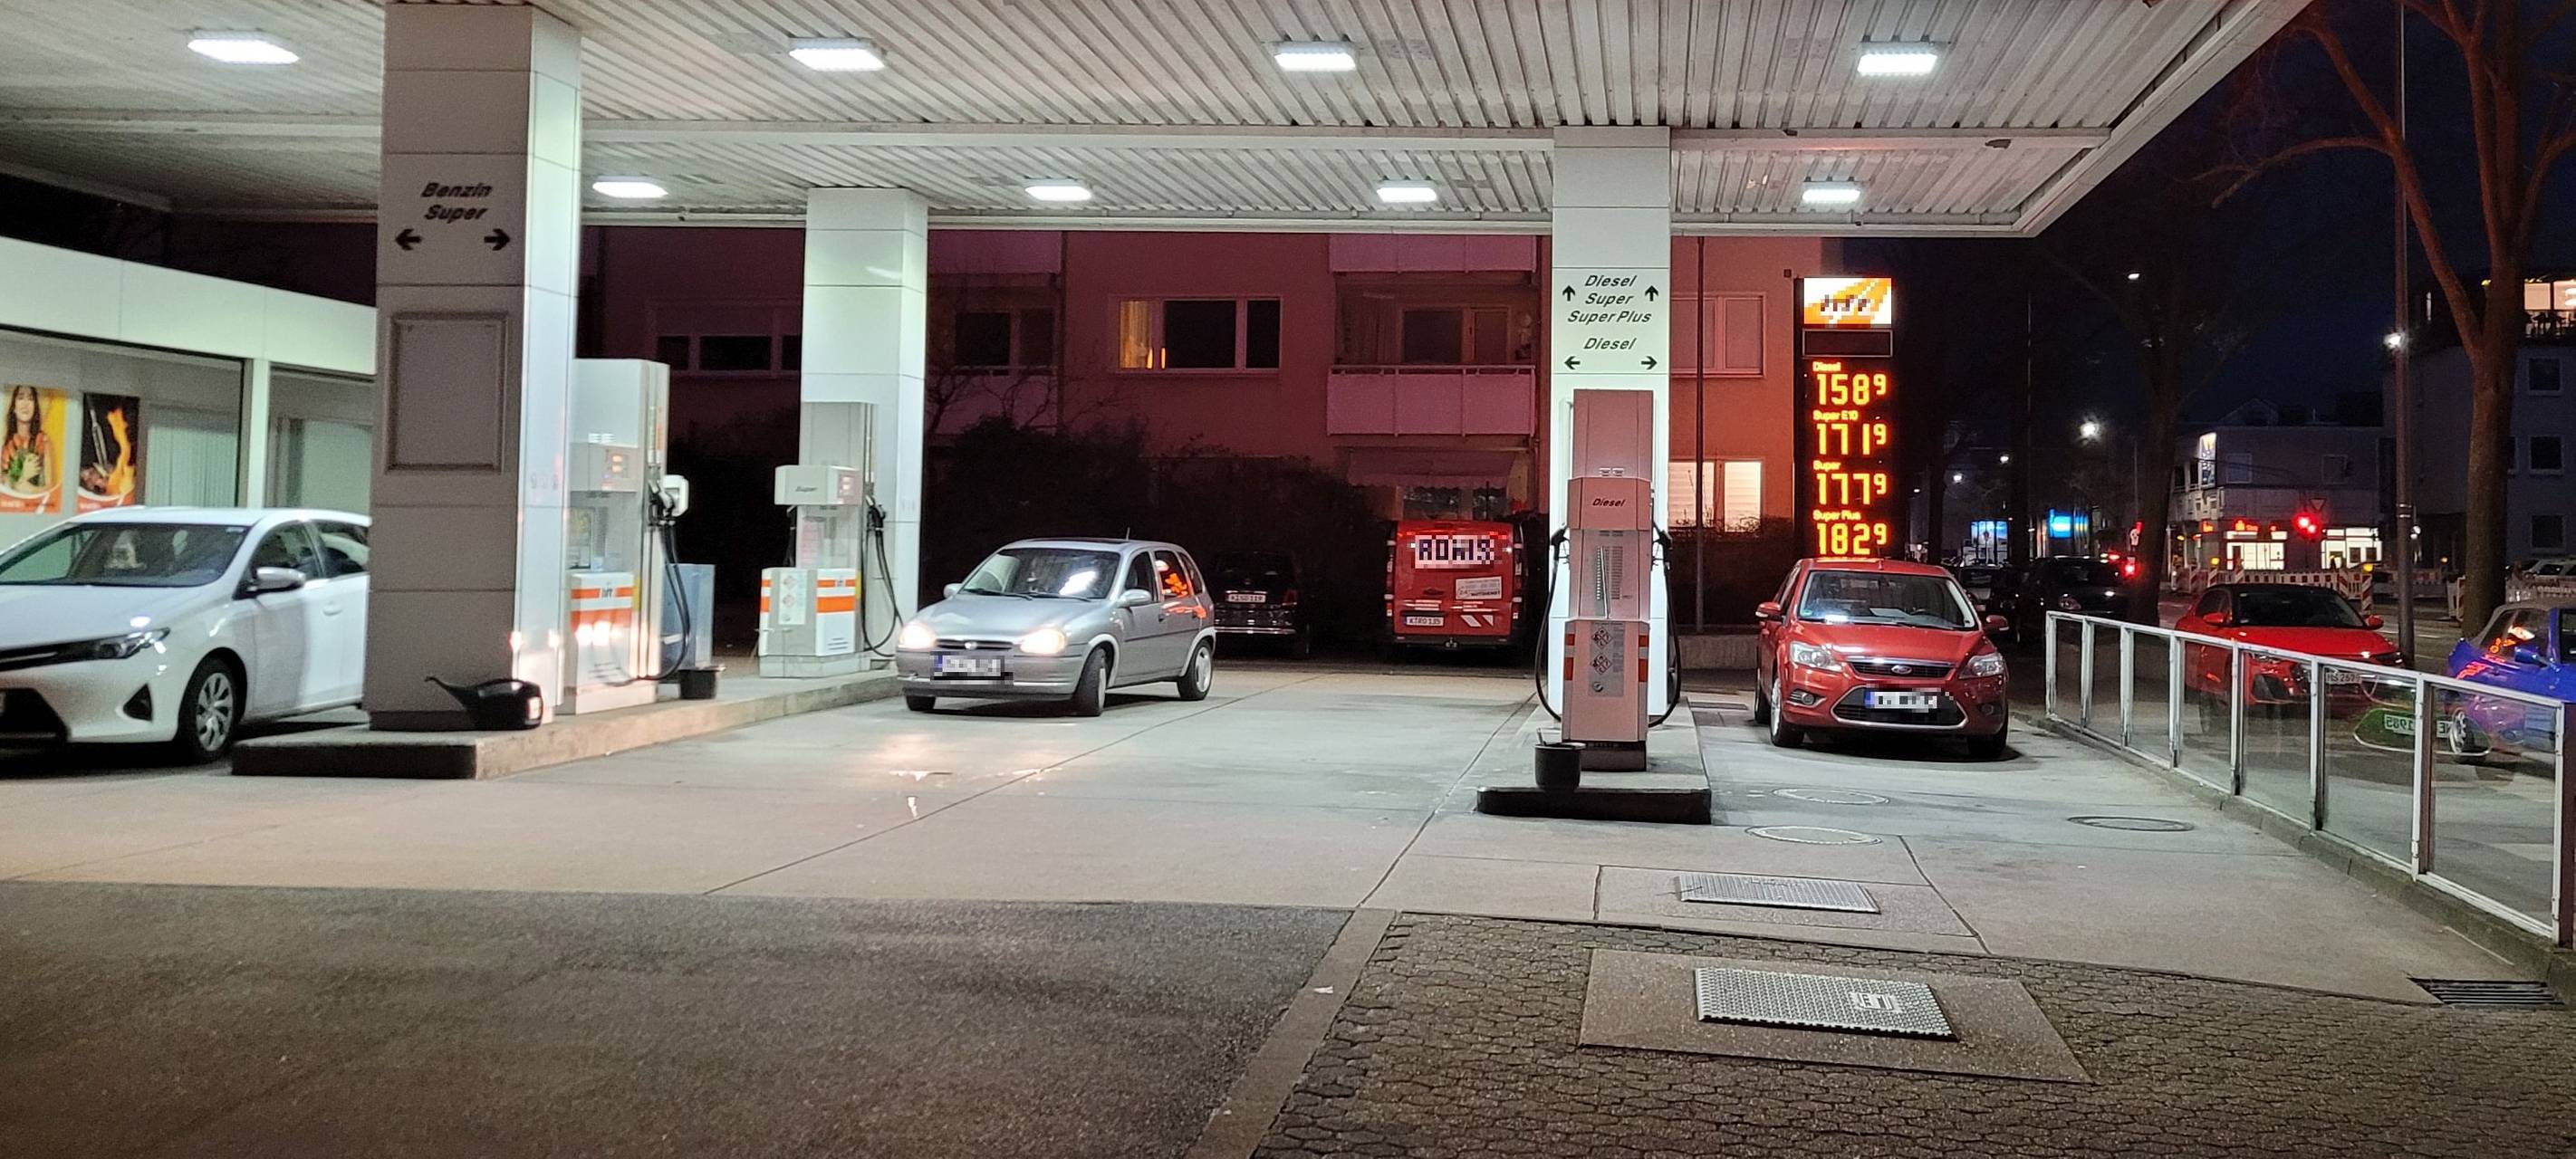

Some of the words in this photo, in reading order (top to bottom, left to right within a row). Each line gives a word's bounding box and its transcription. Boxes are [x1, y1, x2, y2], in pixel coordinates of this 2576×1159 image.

[420, 182, 493, 198] Benzin
[424, 204, 488, 224] Super
[1584, 274, 1638, 287] Diesel
[1585, 292, 1634, 308] Super
[1567, 311, 1616, 326] Super
[1616, 311, 1652, 322] Plus
[1583, 337, 1637, 350] Diesel
[1812, 409, 1841, 422] Super
[1841, 410, 1859, 421] E10
[1812, 460, 1841, 472] Super
[1592, 498, 1627, 507] Diesel
[1812, 510, 1841, 522] Super
[1841, 509, 1861, 521] Plus
